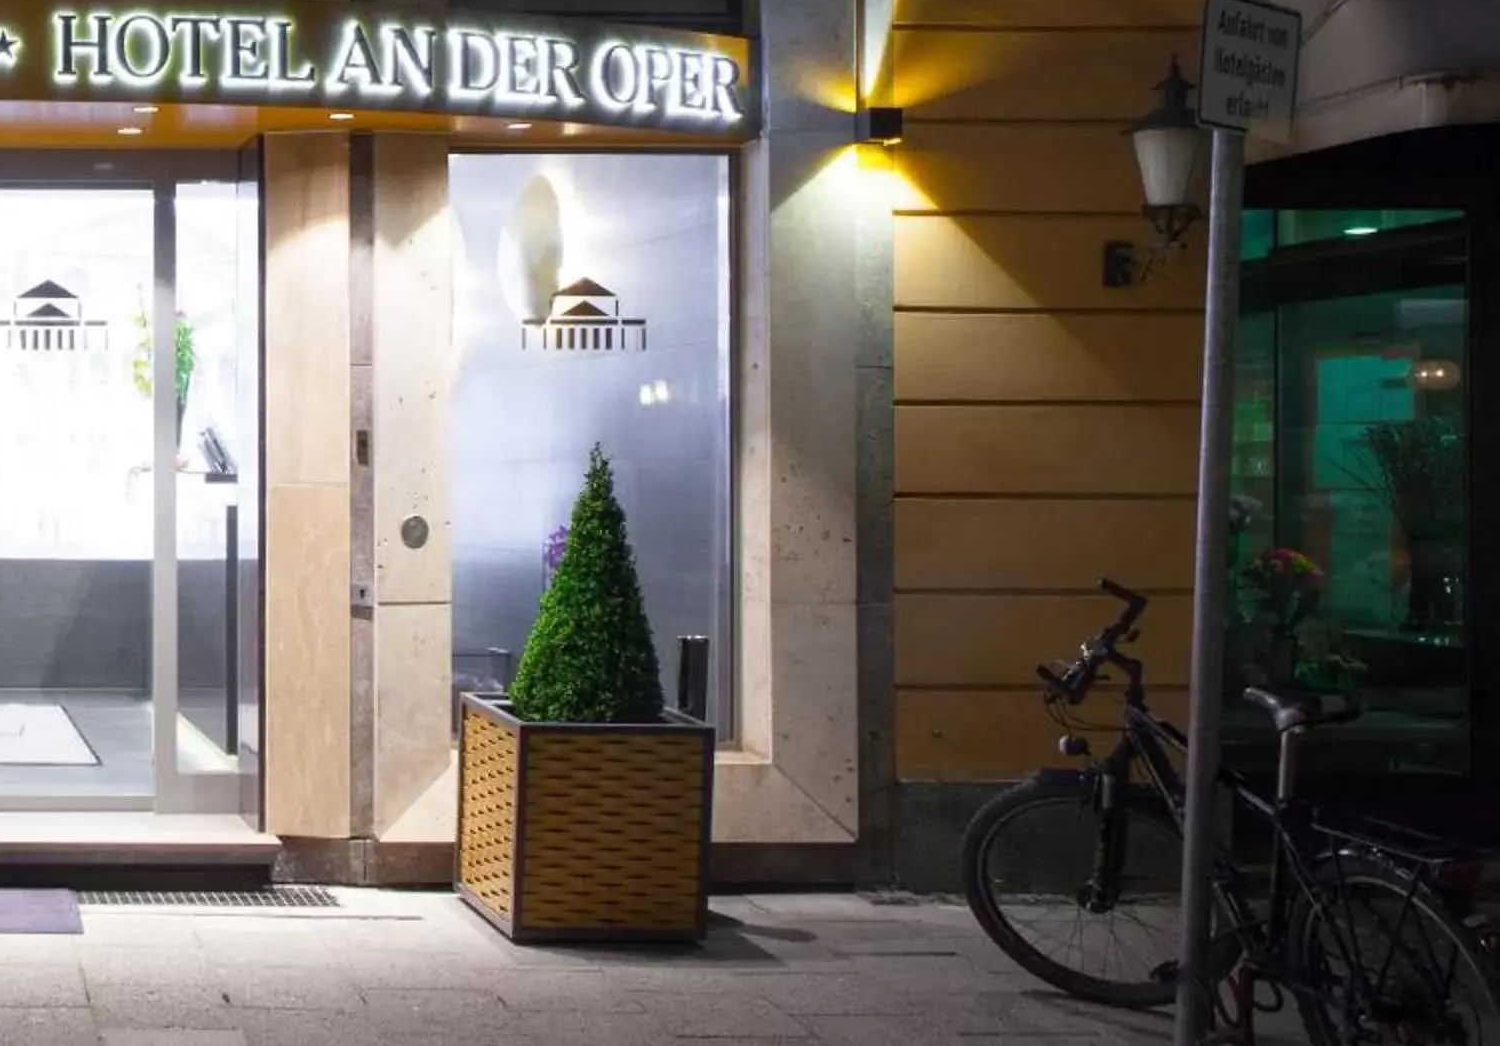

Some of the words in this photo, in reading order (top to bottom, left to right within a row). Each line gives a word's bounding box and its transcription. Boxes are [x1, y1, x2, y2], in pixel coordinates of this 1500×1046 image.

[53, 11, 316, 84] HOTEL
[326, 22, 436, 94] AN
[451, 30, 585, 105] DER
[594, 42, 745, 122] OPER
